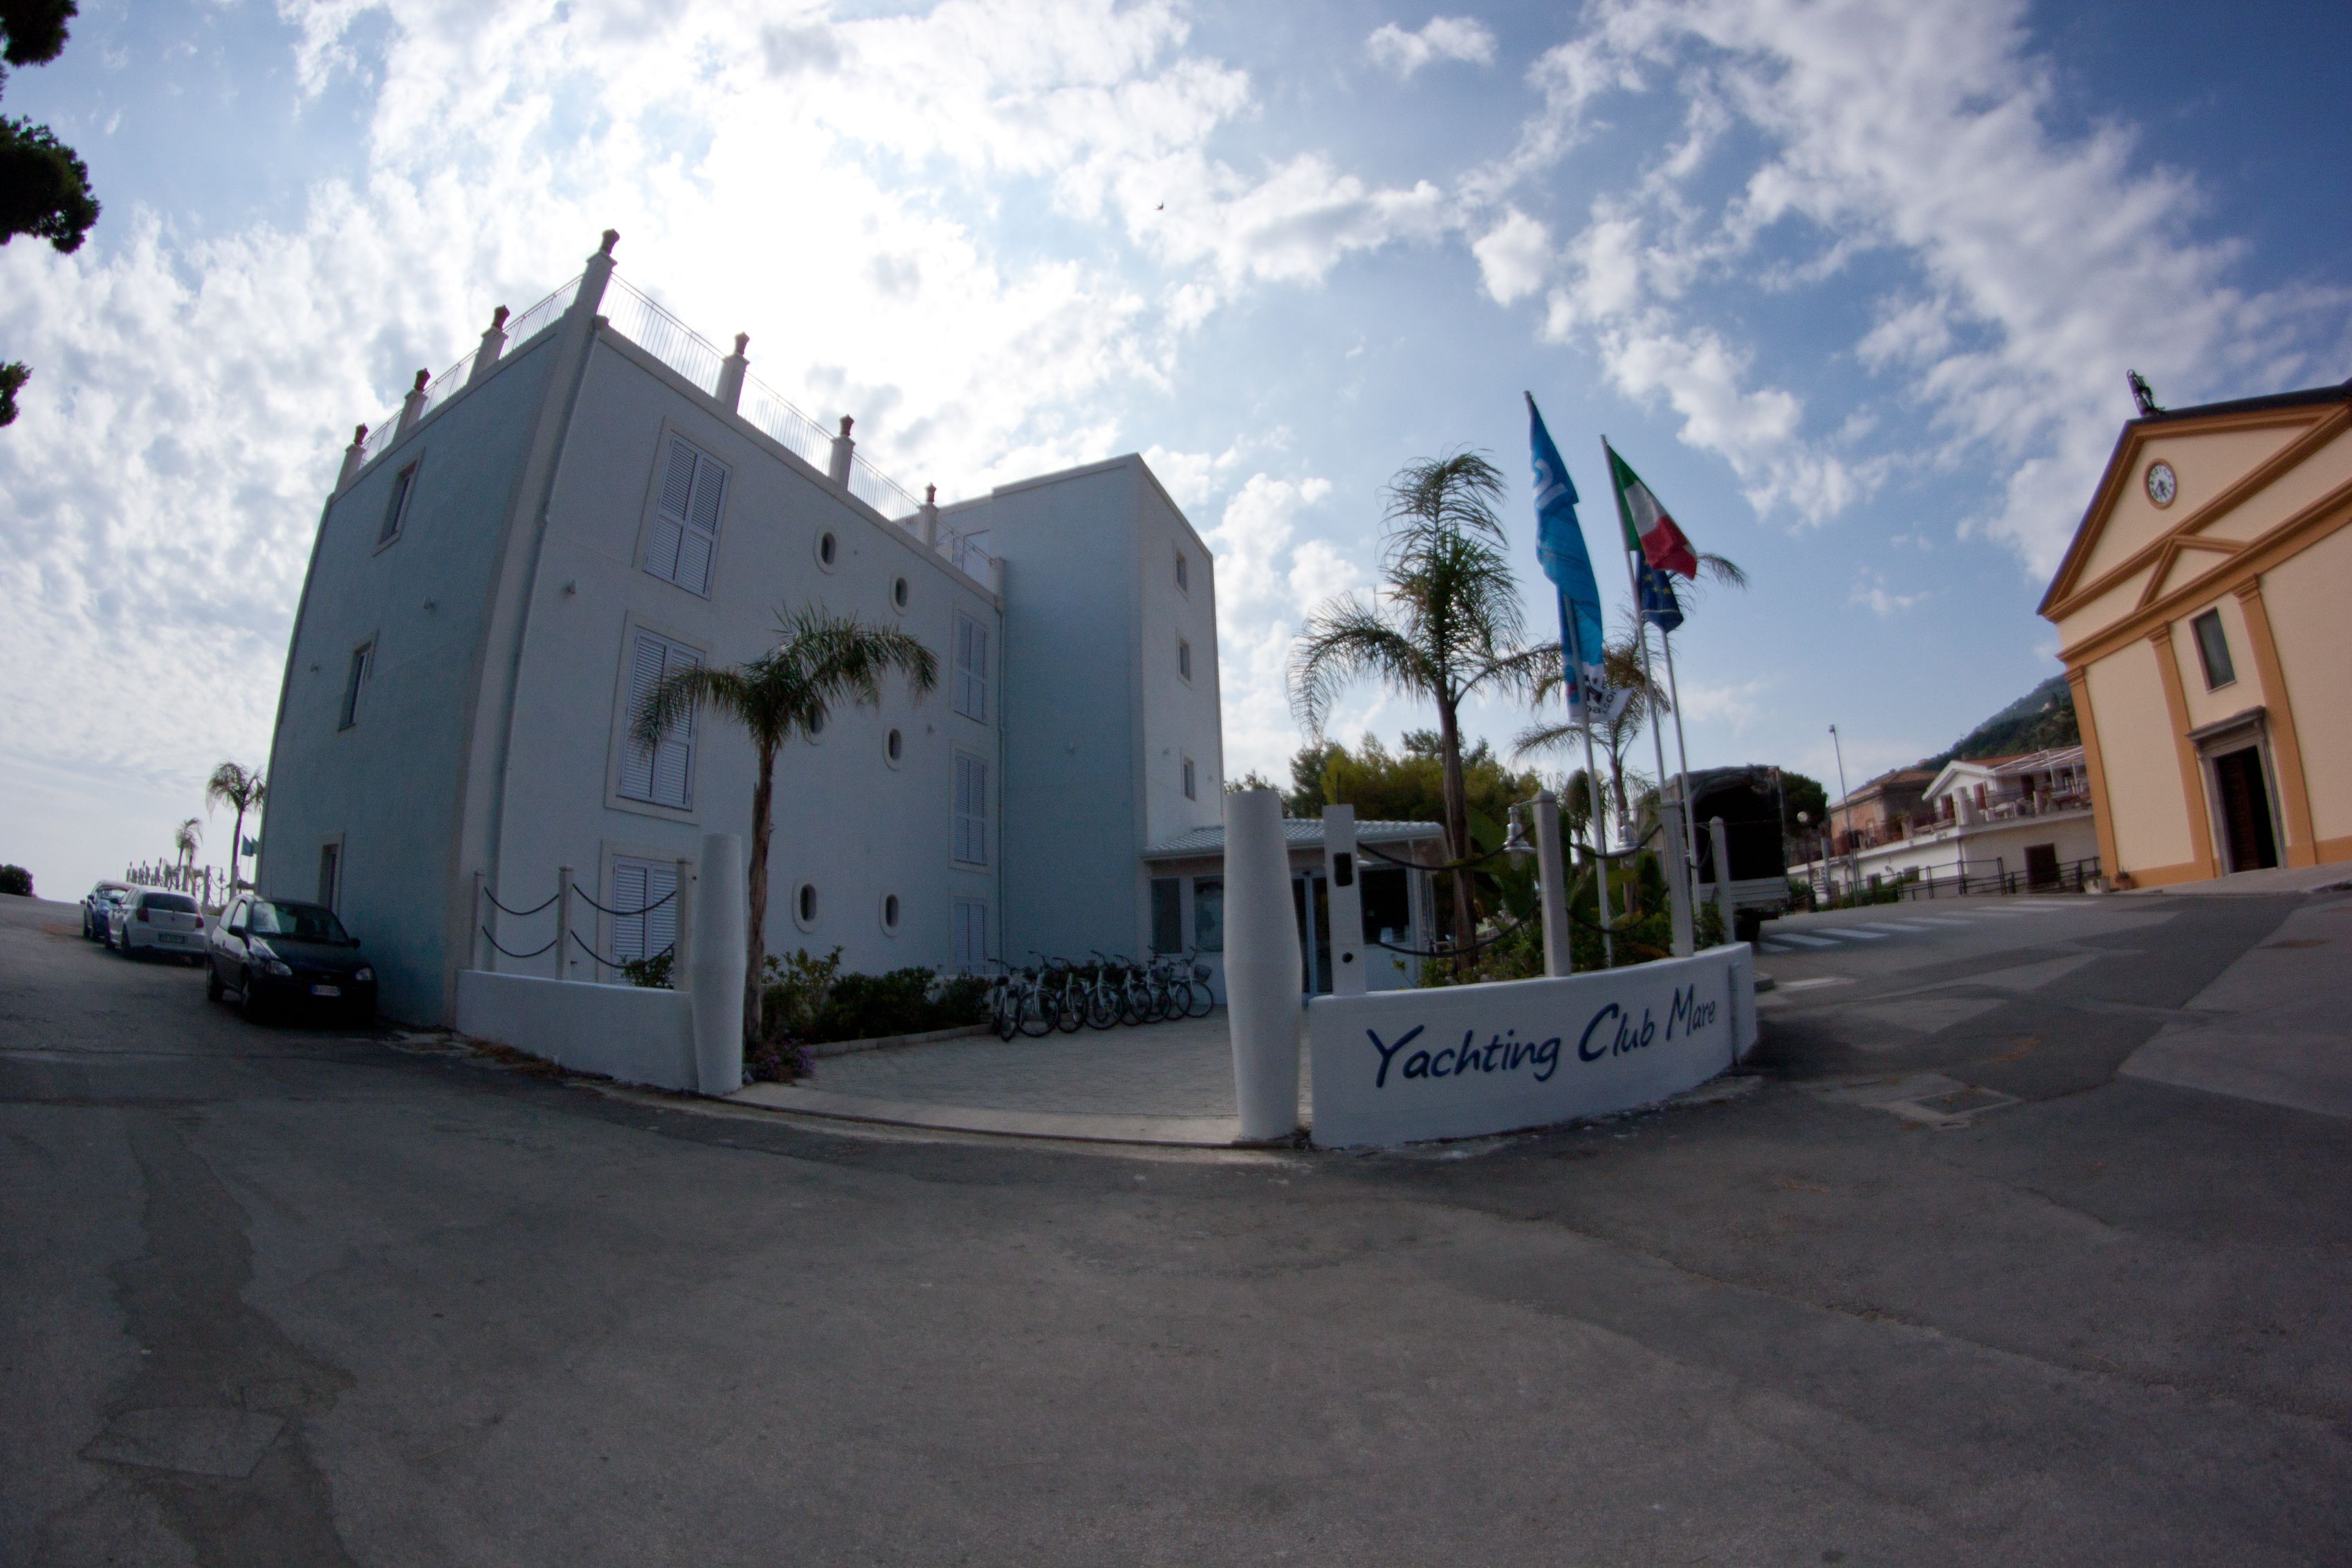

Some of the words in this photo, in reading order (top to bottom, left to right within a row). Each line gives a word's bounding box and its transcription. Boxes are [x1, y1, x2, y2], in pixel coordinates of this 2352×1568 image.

[1366, 1024, 1561, 1088] Yachting
[1577, 1002, 1655, 1063] Club
[1665, 983, 1717, 1041] Mare
